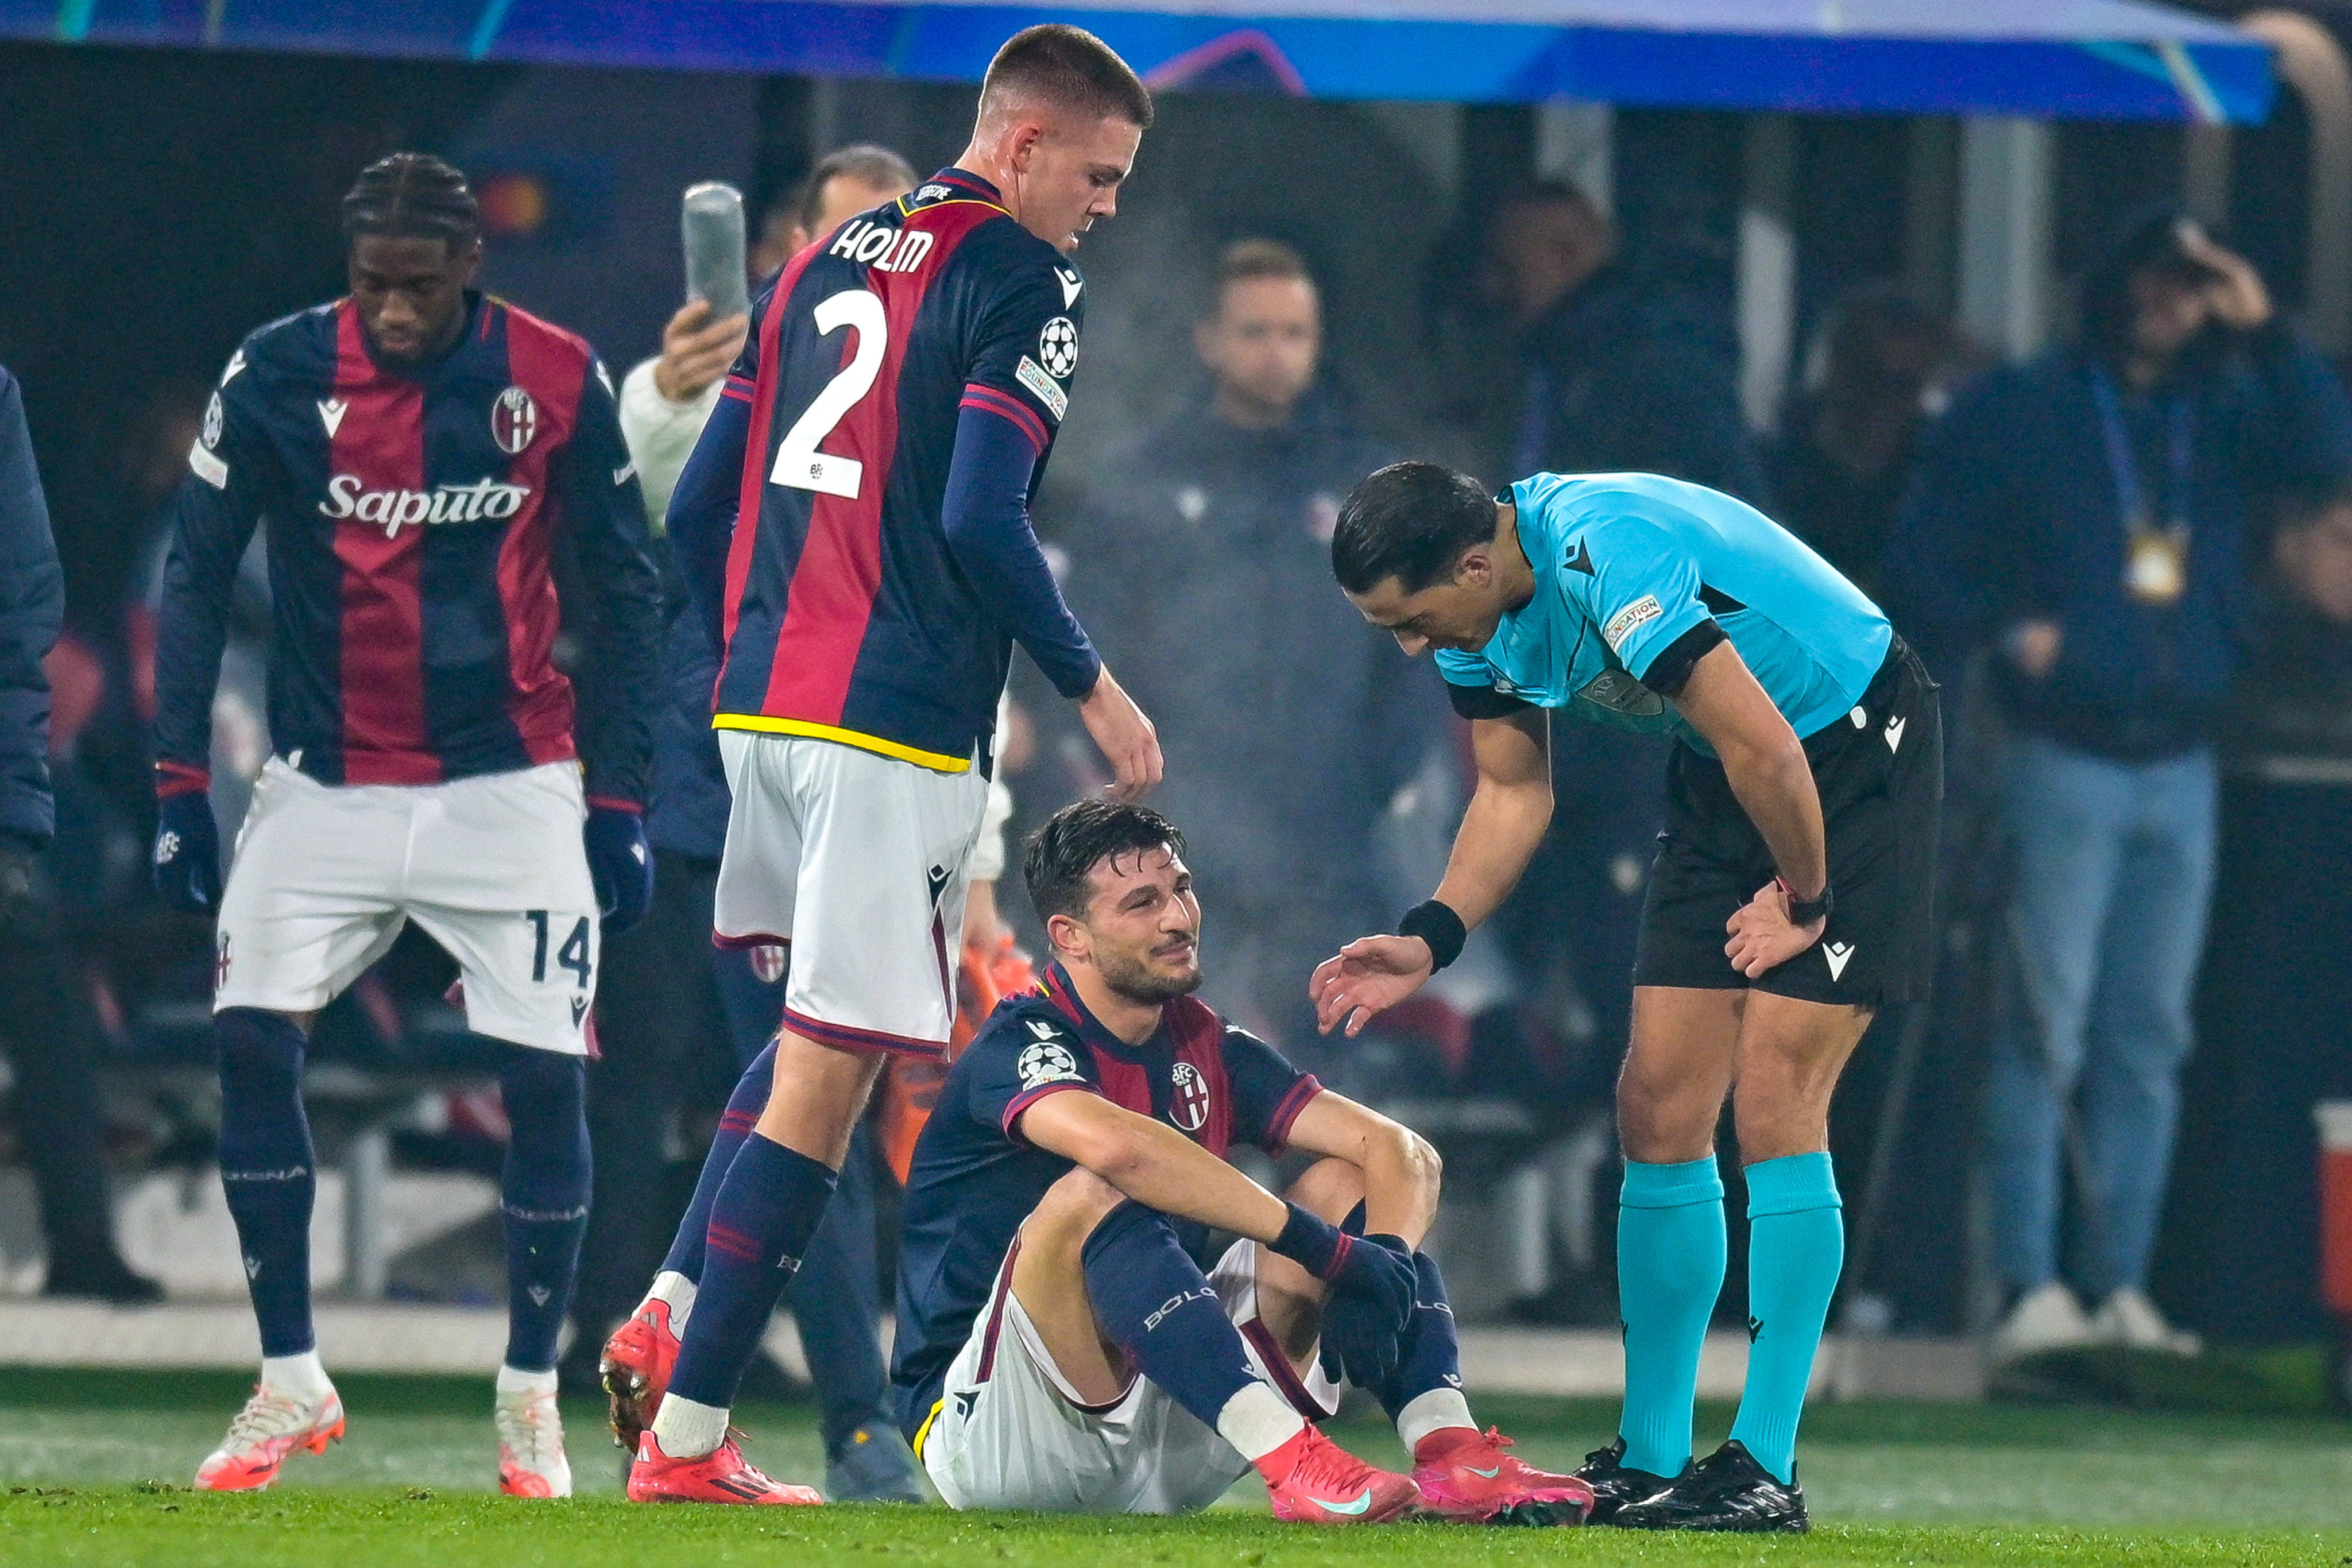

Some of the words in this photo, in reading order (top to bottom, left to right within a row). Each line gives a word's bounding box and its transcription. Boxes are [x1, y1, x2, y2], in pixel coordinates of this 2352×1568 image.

[829, 220, 934, 273] HOLM
[769, 289, 888, 500] 2
[319, 474, 531, 539] Saputo
[526, 910, 592, 988] 14
